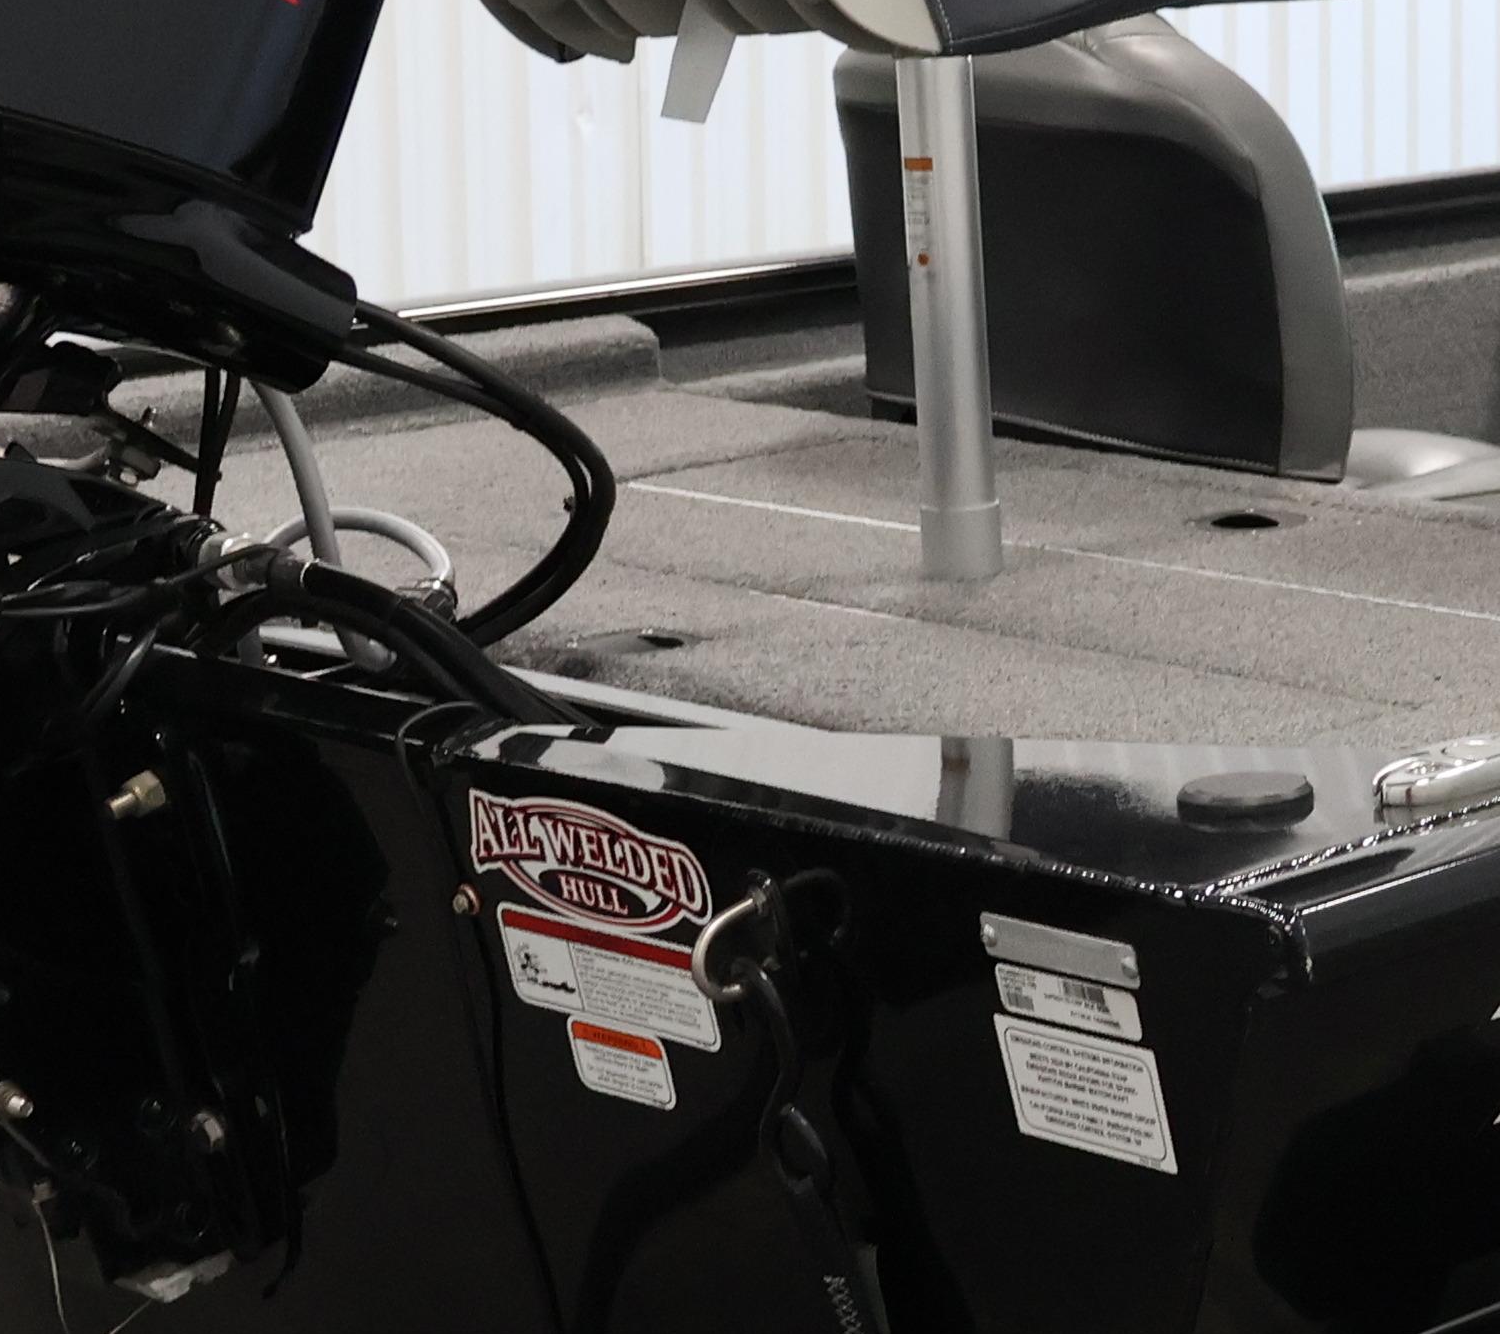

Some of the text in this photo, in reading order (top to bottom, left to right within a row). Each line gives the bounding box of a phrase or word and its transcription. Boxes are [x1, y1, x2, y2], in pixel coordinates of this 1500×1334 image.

[476, 797, 705, 912] ALL WELDED
[557, 873, 630, 916] HULL
